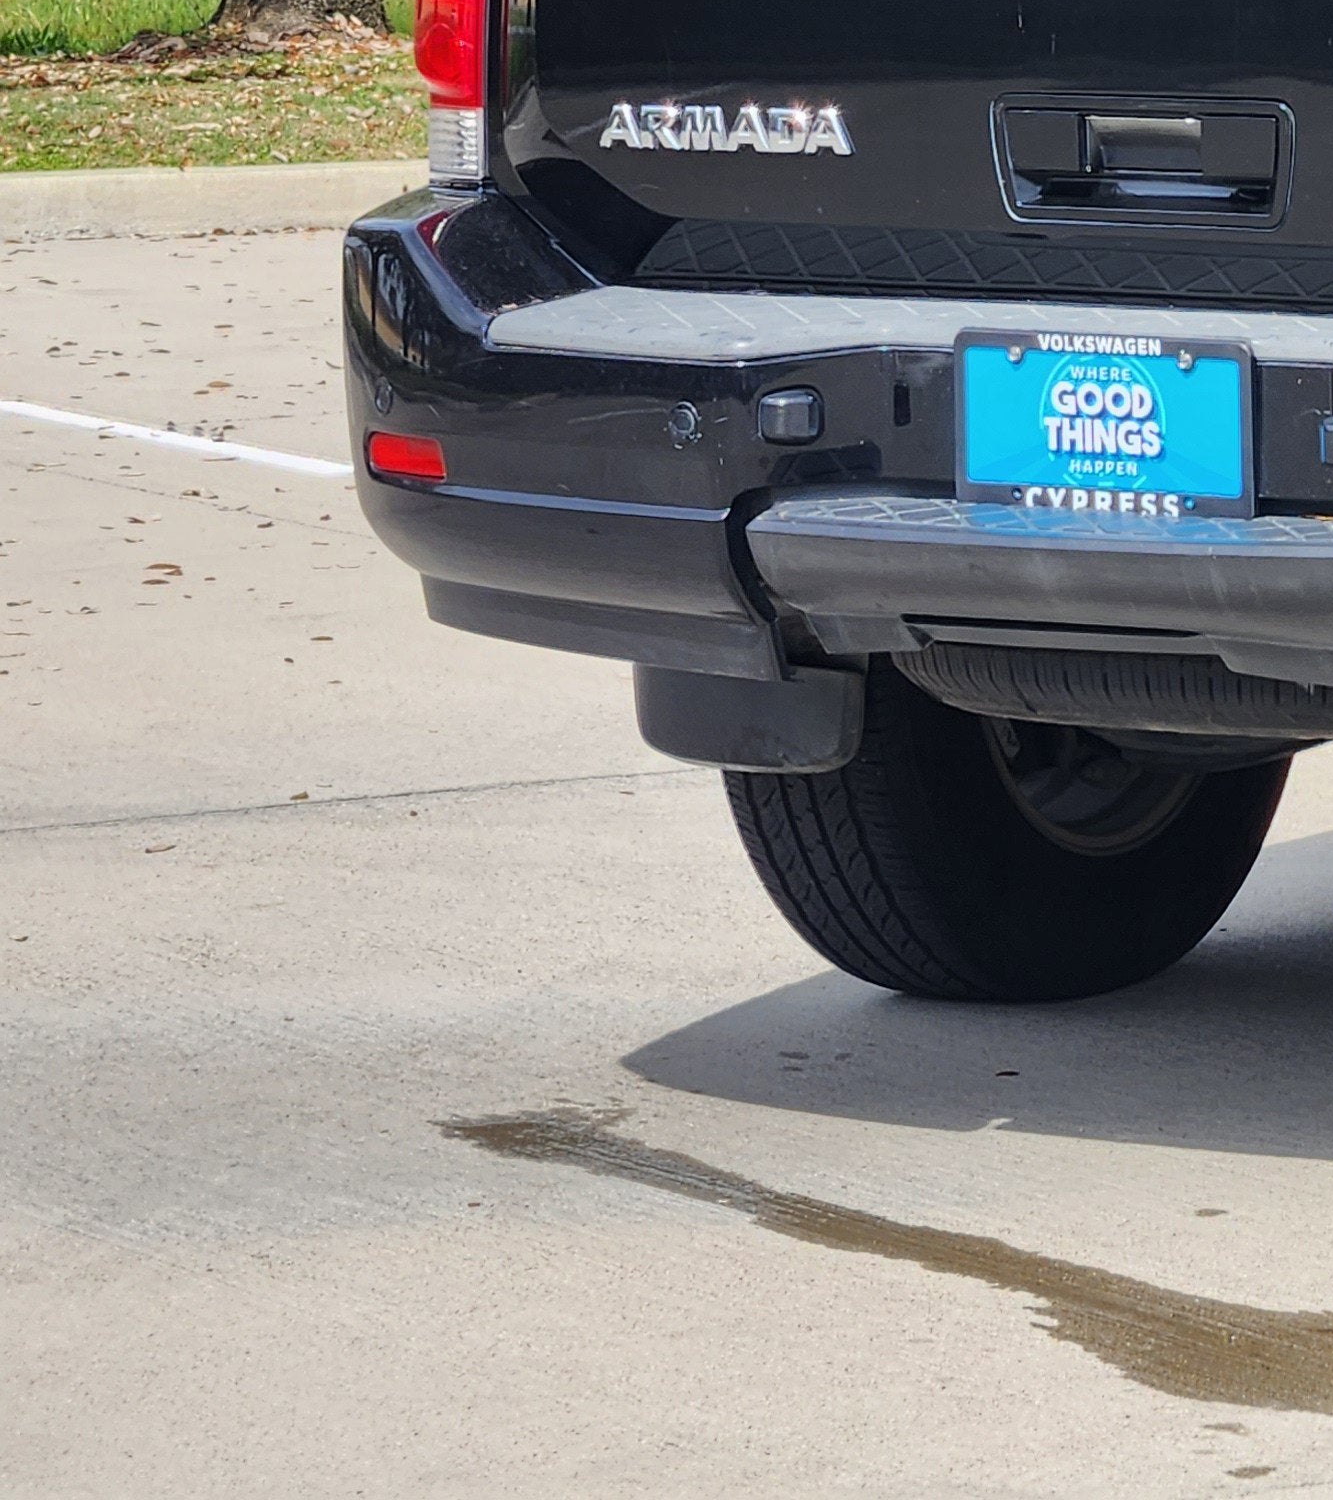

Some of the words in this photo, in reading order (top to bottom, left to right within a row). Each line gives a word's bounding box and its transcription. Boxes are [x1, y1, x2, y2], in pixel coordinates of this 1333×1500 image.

[600, 102, 855, 156] ARMADA
[1037, 333, 1162, 357] VOLKSWAGEN
[1069, 364, 1132, 382] WHERE
[1050, 380, 1154, 419] GOOD
[1043, 416, 1163, 457] THINGS
[1068, 458, 1138, 477] HAPPEN
[1026, 486, 1180, 517] CYPRESS
